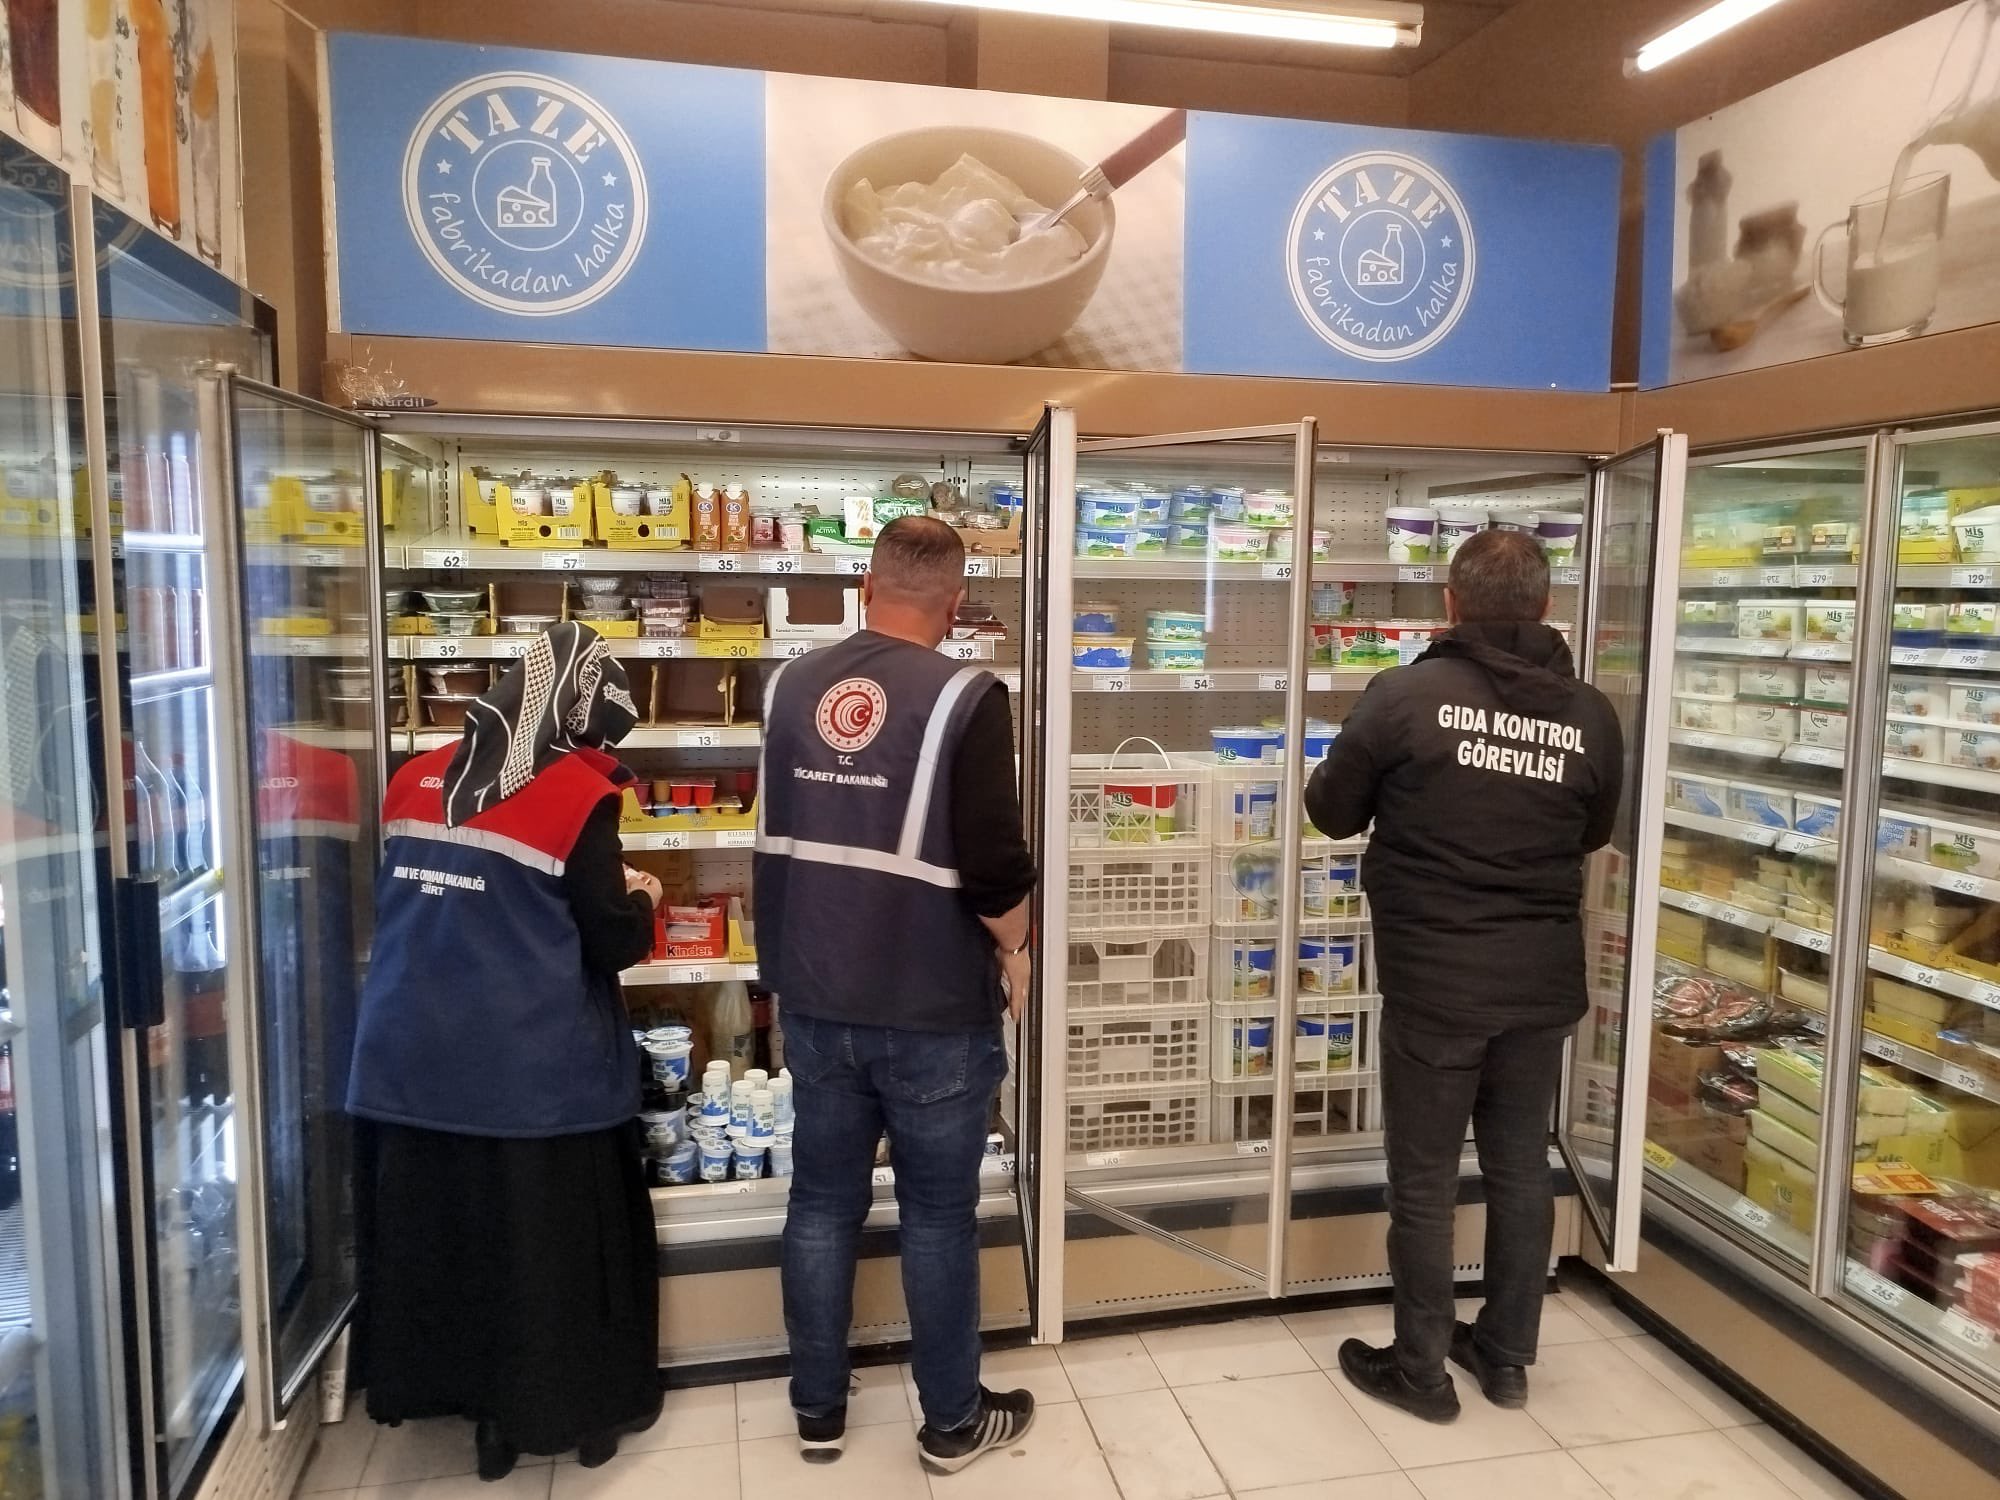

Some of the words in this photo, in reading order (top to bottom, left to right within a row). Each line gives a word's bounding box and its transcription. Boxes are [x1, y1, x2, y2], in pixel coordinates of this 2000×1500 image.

[440, 94, 607, 164] TAZE
[1317, 170, 1446, 229] TAZE
[429, 192, 572, 294] fabrikadan
[575, 203, 625, 278] halka
[1306, 256, 1413, 342] fabrikadan
[1416, 262, 1457, 328] halka
[443, 556, 460, 567] 62
[563, 559, 577, 568] 57
[718, 559, 733, 570] 35
[776, 561, 793, 572] 39
[852, 562, 868, 573] 99
[967, 564, 981, 574] 57
[1276, 568, 1291, 577] 49
[1413, 571, 1426, 579] 125
[1811, 575, 1827, 583] 379
[1968, 574, 1984, 584] 129
[439, 646, 456, 656] 39
[657, 646, 673, 657] 35
[730, 646, 748, 657] 30
[958, 648, 973, 658] 39
[1960, 655, 1978, 664] 198
[1109, 681, 1123, 691] 79
[1193, 679, 1208, 689] 54
[1274, 680, 1288, 690] 82
[1438, 704, 1488, 733] GIDA
[1493, 711, 1585, 754] KONTROL
[698, 736, 711, 746] 13
[1457, 738, 1566, 783] GÖREVLİSİ
[662, 837, 680, 848] 46
[409, 867, 420, 879] VE
[1953, 880, 1975, 891] 245
[1809, 938, 1823, 948] 99
[689, 972, 702, 981] 18
[1917, 972, 1934, 985] 94
[1878, 1045, 1895, 1057] 289
[1958, 1074, 1976, 1089] 375
[1871, 1284, 1895, 1301] 265
